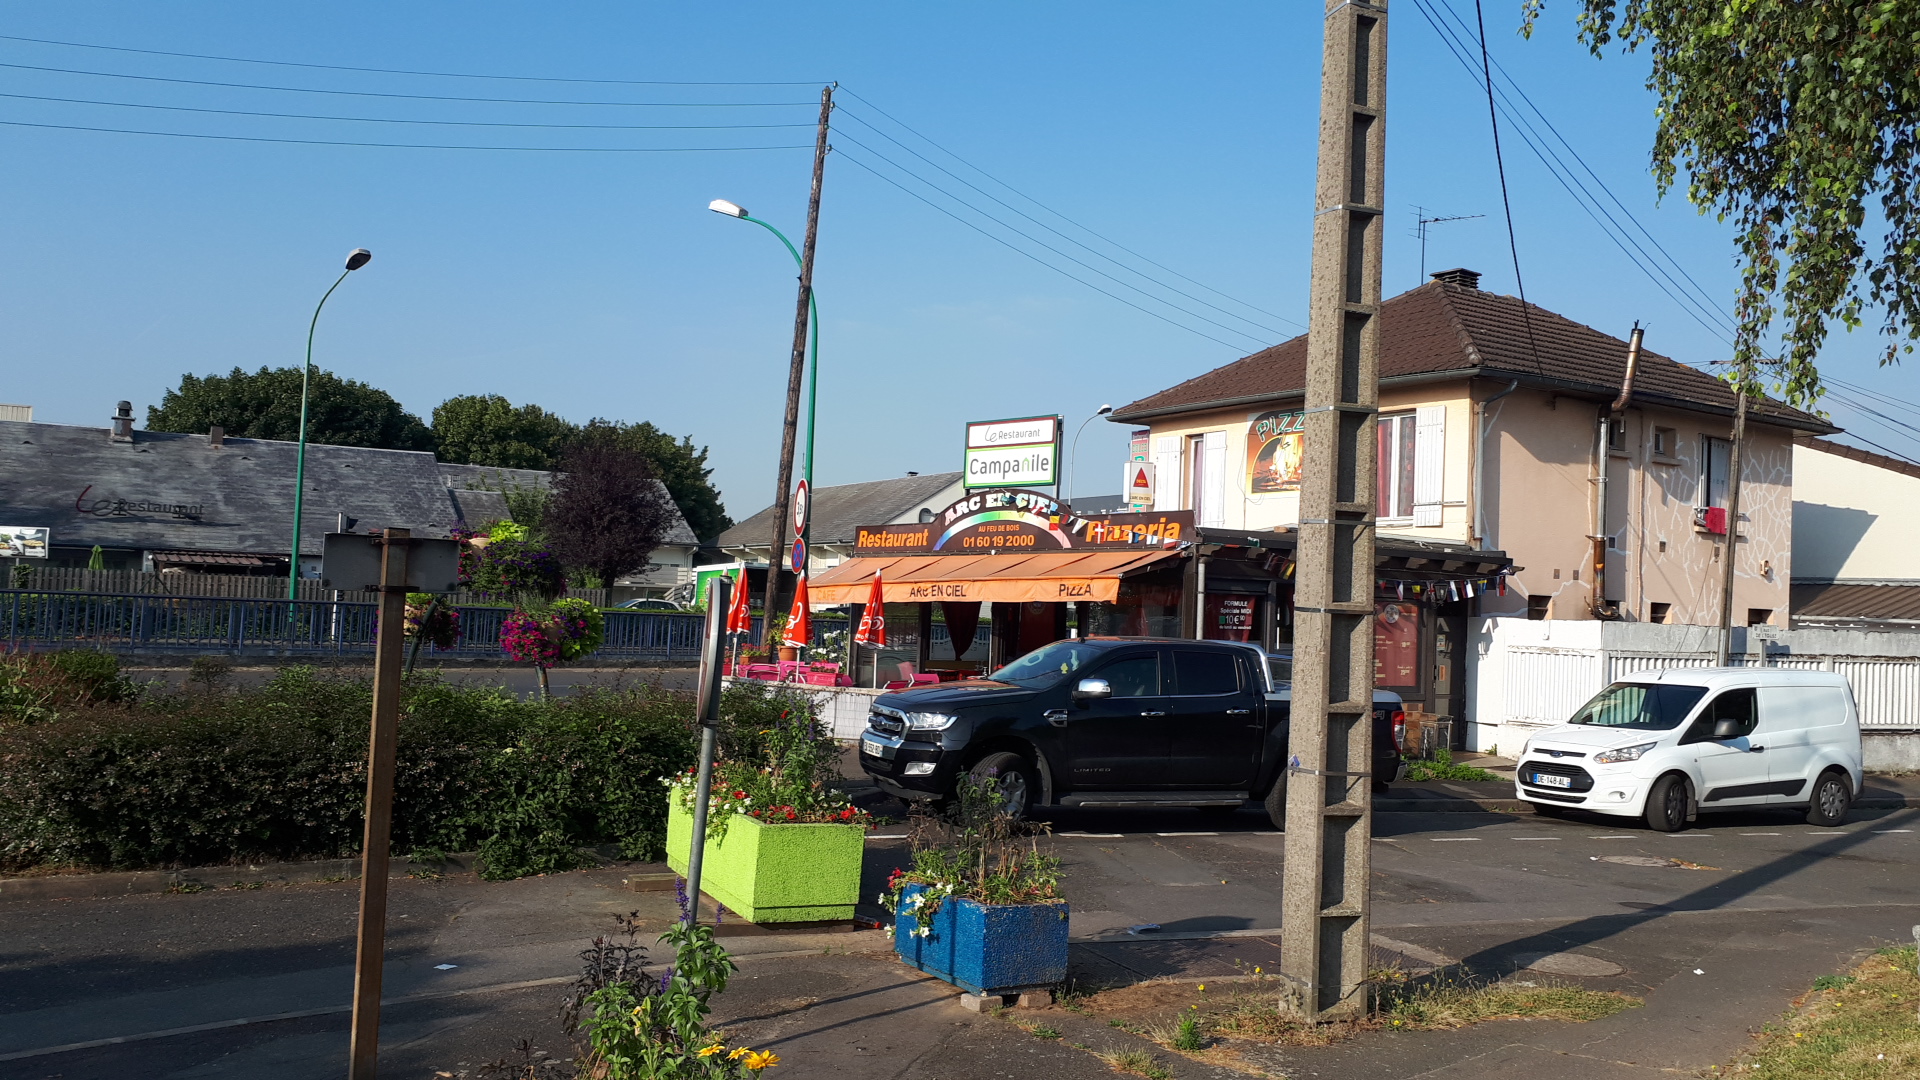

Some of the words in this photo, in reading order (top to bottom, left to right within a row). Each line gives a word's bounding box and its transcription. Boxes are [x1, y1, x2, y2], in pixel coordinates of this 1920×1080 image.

[998, 428, 1041, 440] Restaurant
[1256, 411, 1304, 442] PIZZ
[970, 454, 1049, 480] Campanile
[117, 498, 205, 515] Restaurant
[945, 495, 981, 526] ARC
[1006, 524, 1020, 532] BOIS
[1085, 517, 1181, 543] Pizzeria
[858, 529, 929, 547] Restaurant
[963, 536, 975, 548] 01
[976, 536, 990, 547] 60
[992, 536, 1004, 547] 19
[1005, 535, 1035, 546] 2000
[909, 586, 929, 597] ARC
[931, 584, 944, 597] EN
[945, 584, 967, 597] CIEL
[1058, 583, 1092, 597] PIZZA
